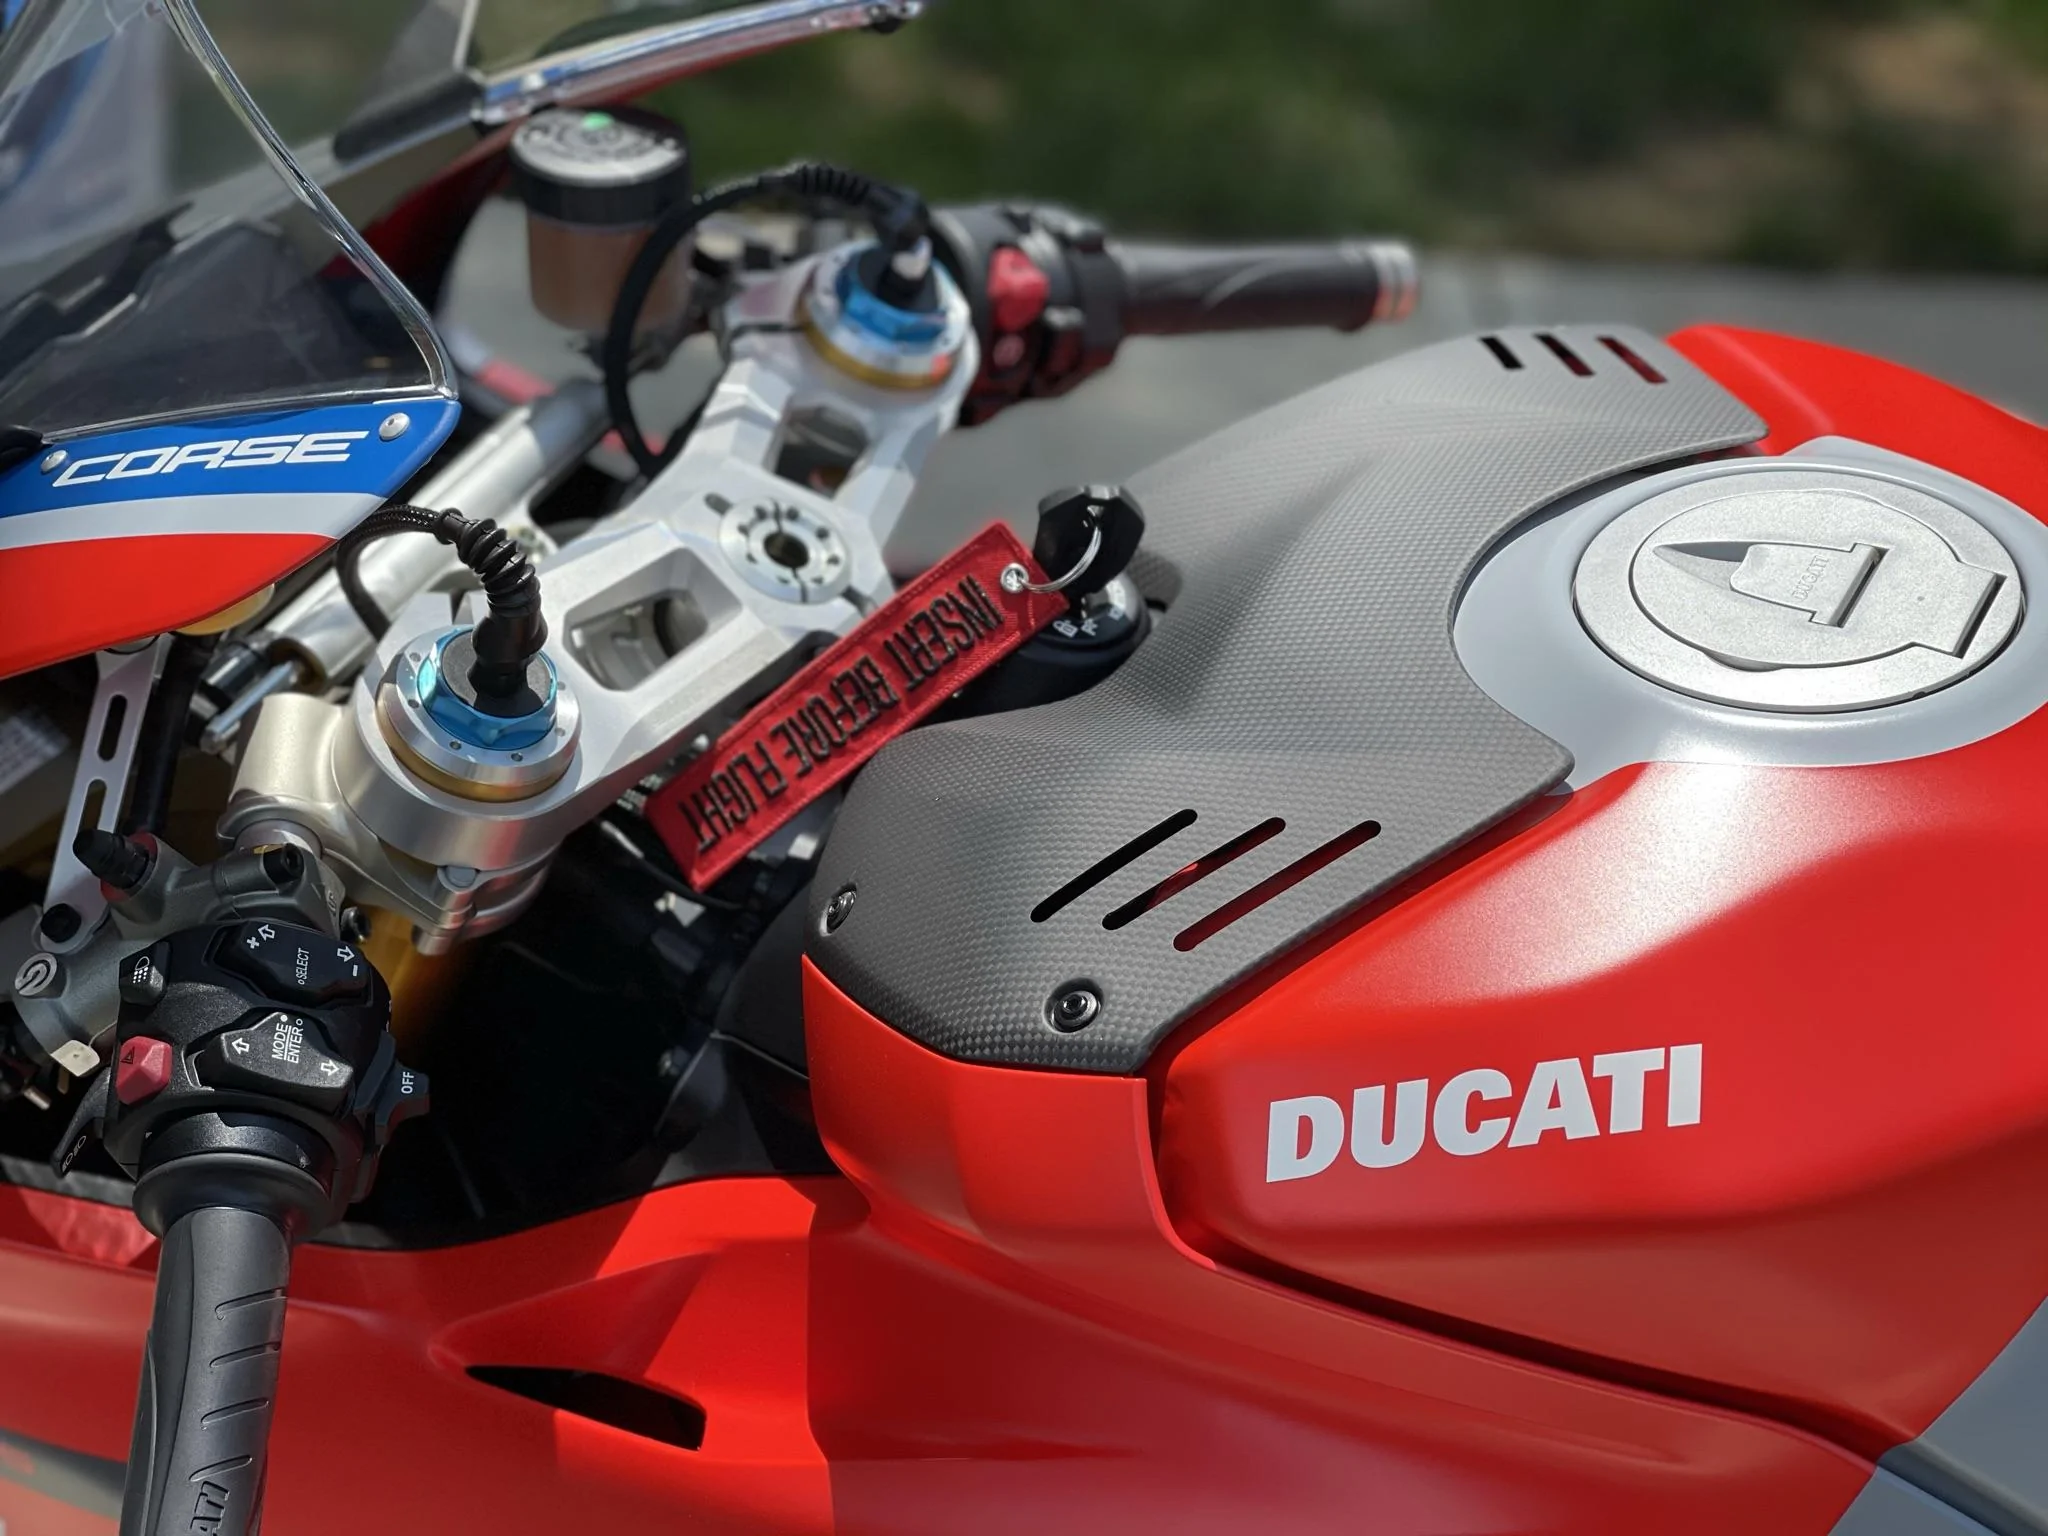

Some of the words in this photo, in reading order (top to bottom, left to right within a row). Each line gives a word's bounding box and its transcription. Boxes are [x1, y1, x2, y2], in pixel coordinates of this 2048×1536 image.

[52, 430, 369, 487] CORSE
[883, 575, 1004, 691] INSERT
[769, 655, 900, 777] BEFORE
[677, 742, 788, 851] FLIGHT
[295, 947, 310, 980] SELECT
[271, 1022, 288, 1060] MODE
[287, 1026, 304, 1064] ENTER
[401, 1071, 415, 1094] OFF
[1266, 1043, 1703, 1183] DUCATI
